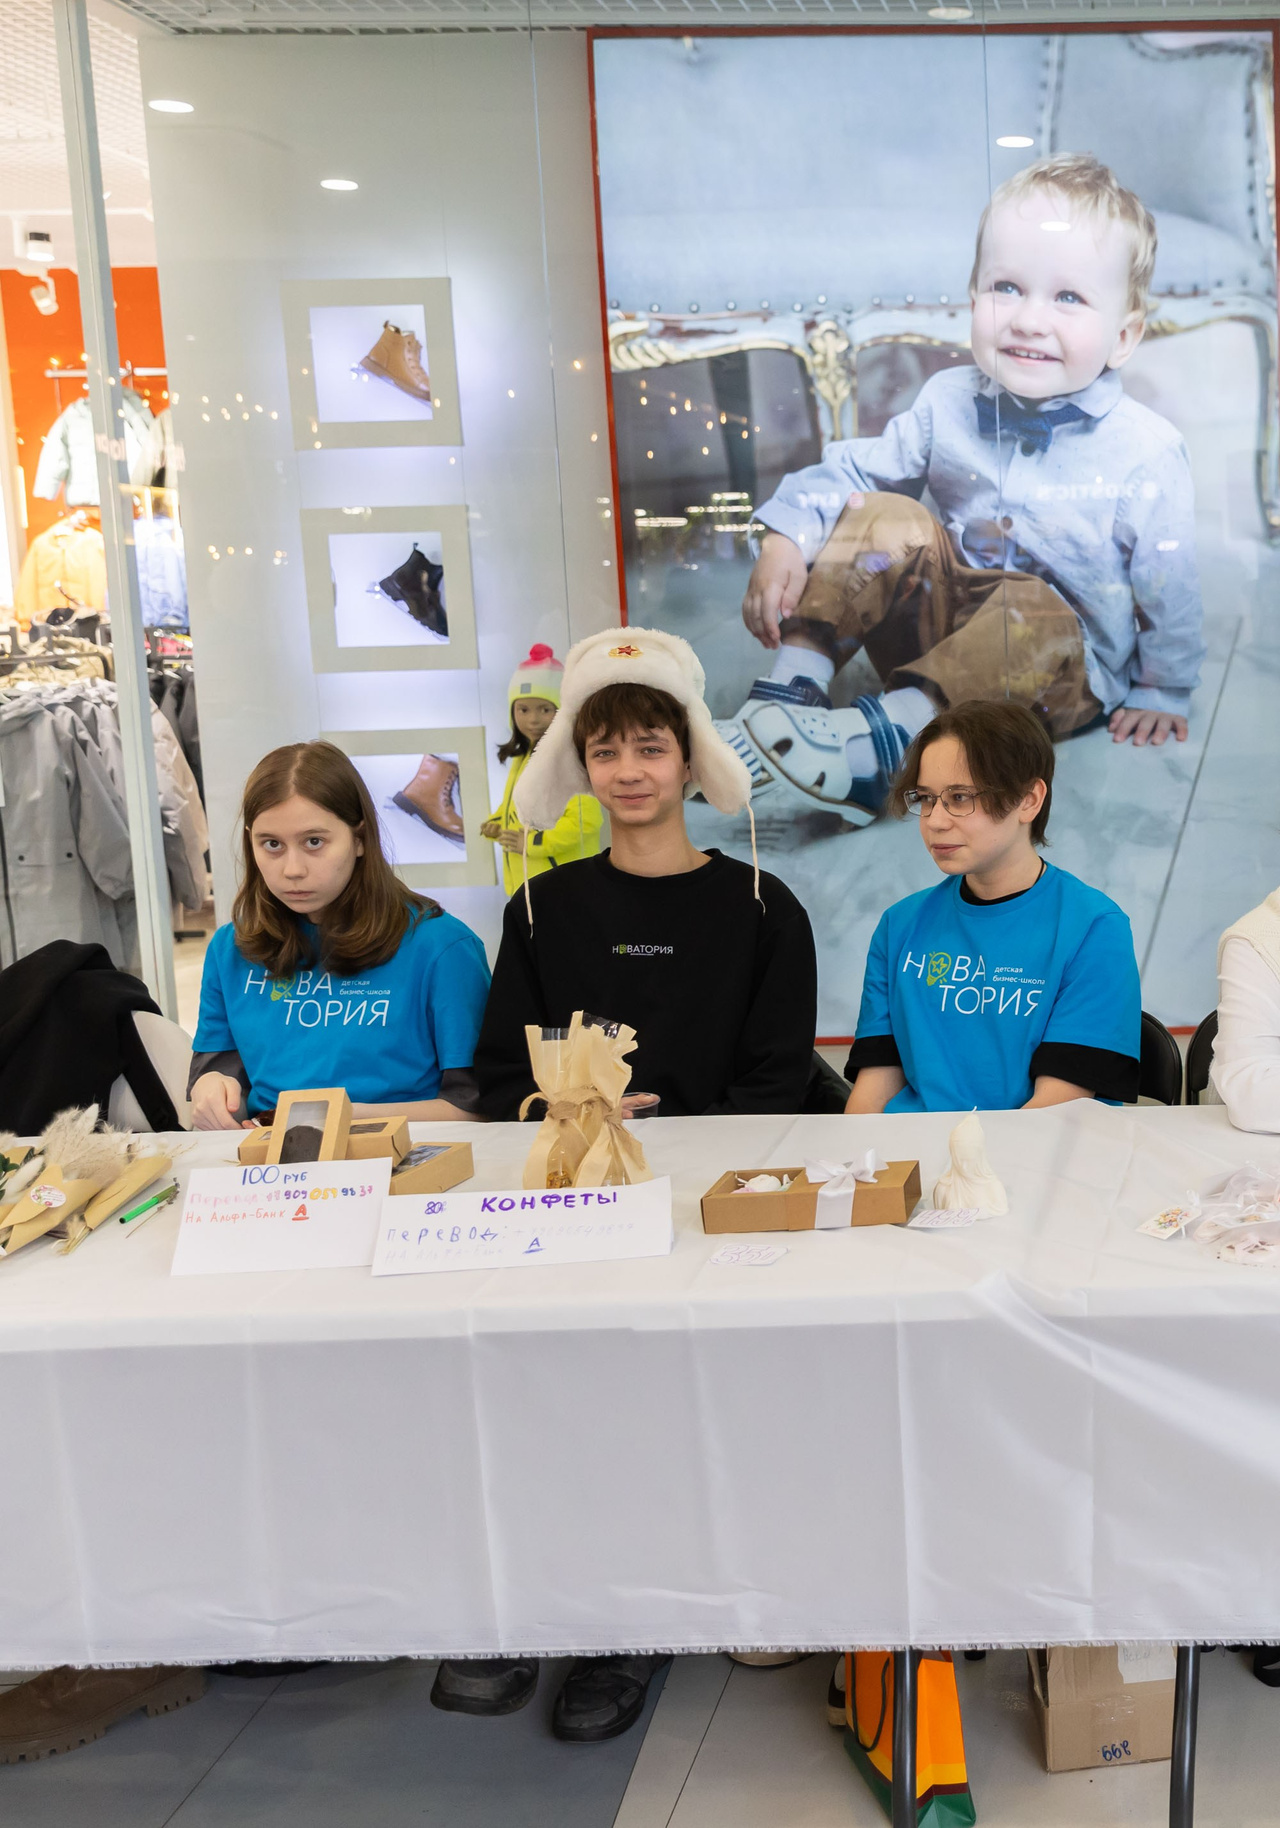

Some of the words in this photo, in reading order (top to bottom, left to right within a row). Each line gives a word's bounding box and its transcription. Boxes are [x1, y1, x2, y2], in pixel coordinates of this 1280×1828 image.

[994, 966, 1024, 974] детская
[341, 979, 371, 987] детская
[992, 975, 1046, 986] бизнес-школа
[339, 987, 391, 996] бизнес-школа
[938, 984, 1043, 1017] ТОРИЯ
[283, 999, 390, 1027] ТОРИЯ
[241, 1165, 280, 1186] 100
[480, 1191, 618, 1214] КОНФЕТЫ
